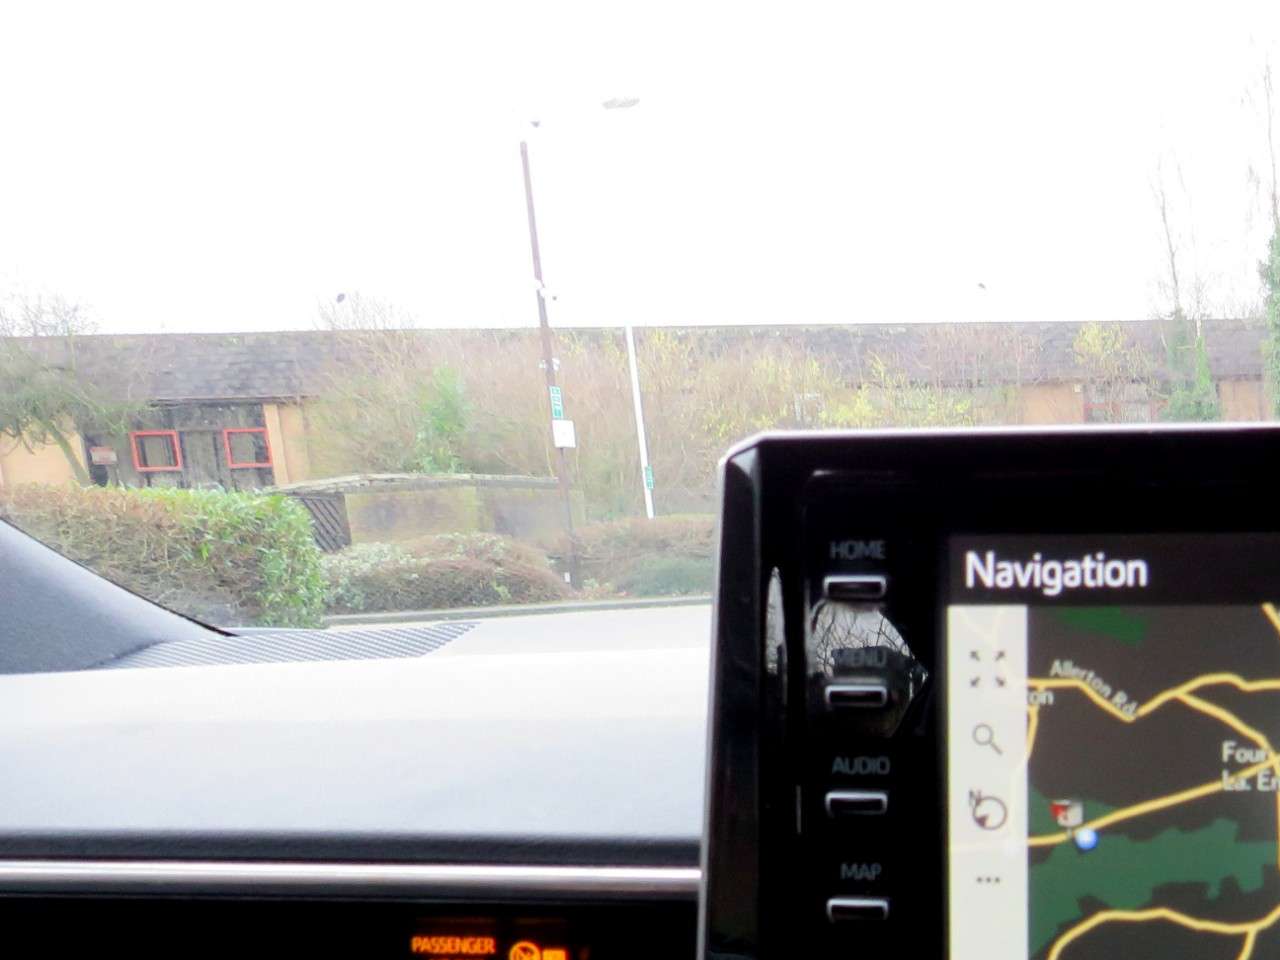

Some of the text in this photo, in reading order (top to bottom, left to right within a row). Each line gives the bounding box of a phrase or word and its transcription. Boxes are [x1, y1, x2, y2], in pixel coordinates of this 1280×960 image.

[830, 541, 887, 559] HOME
[965, 551, 1148, 595] Navigation
[1050, 659, 1112, 698] Allerton
[1222, 741, 1268, 763] Four
[832, 756, 891, 775] AUDIO
[841, 863, 882, 881] MAP
[412, 936, 496, 954] PASSENGER
